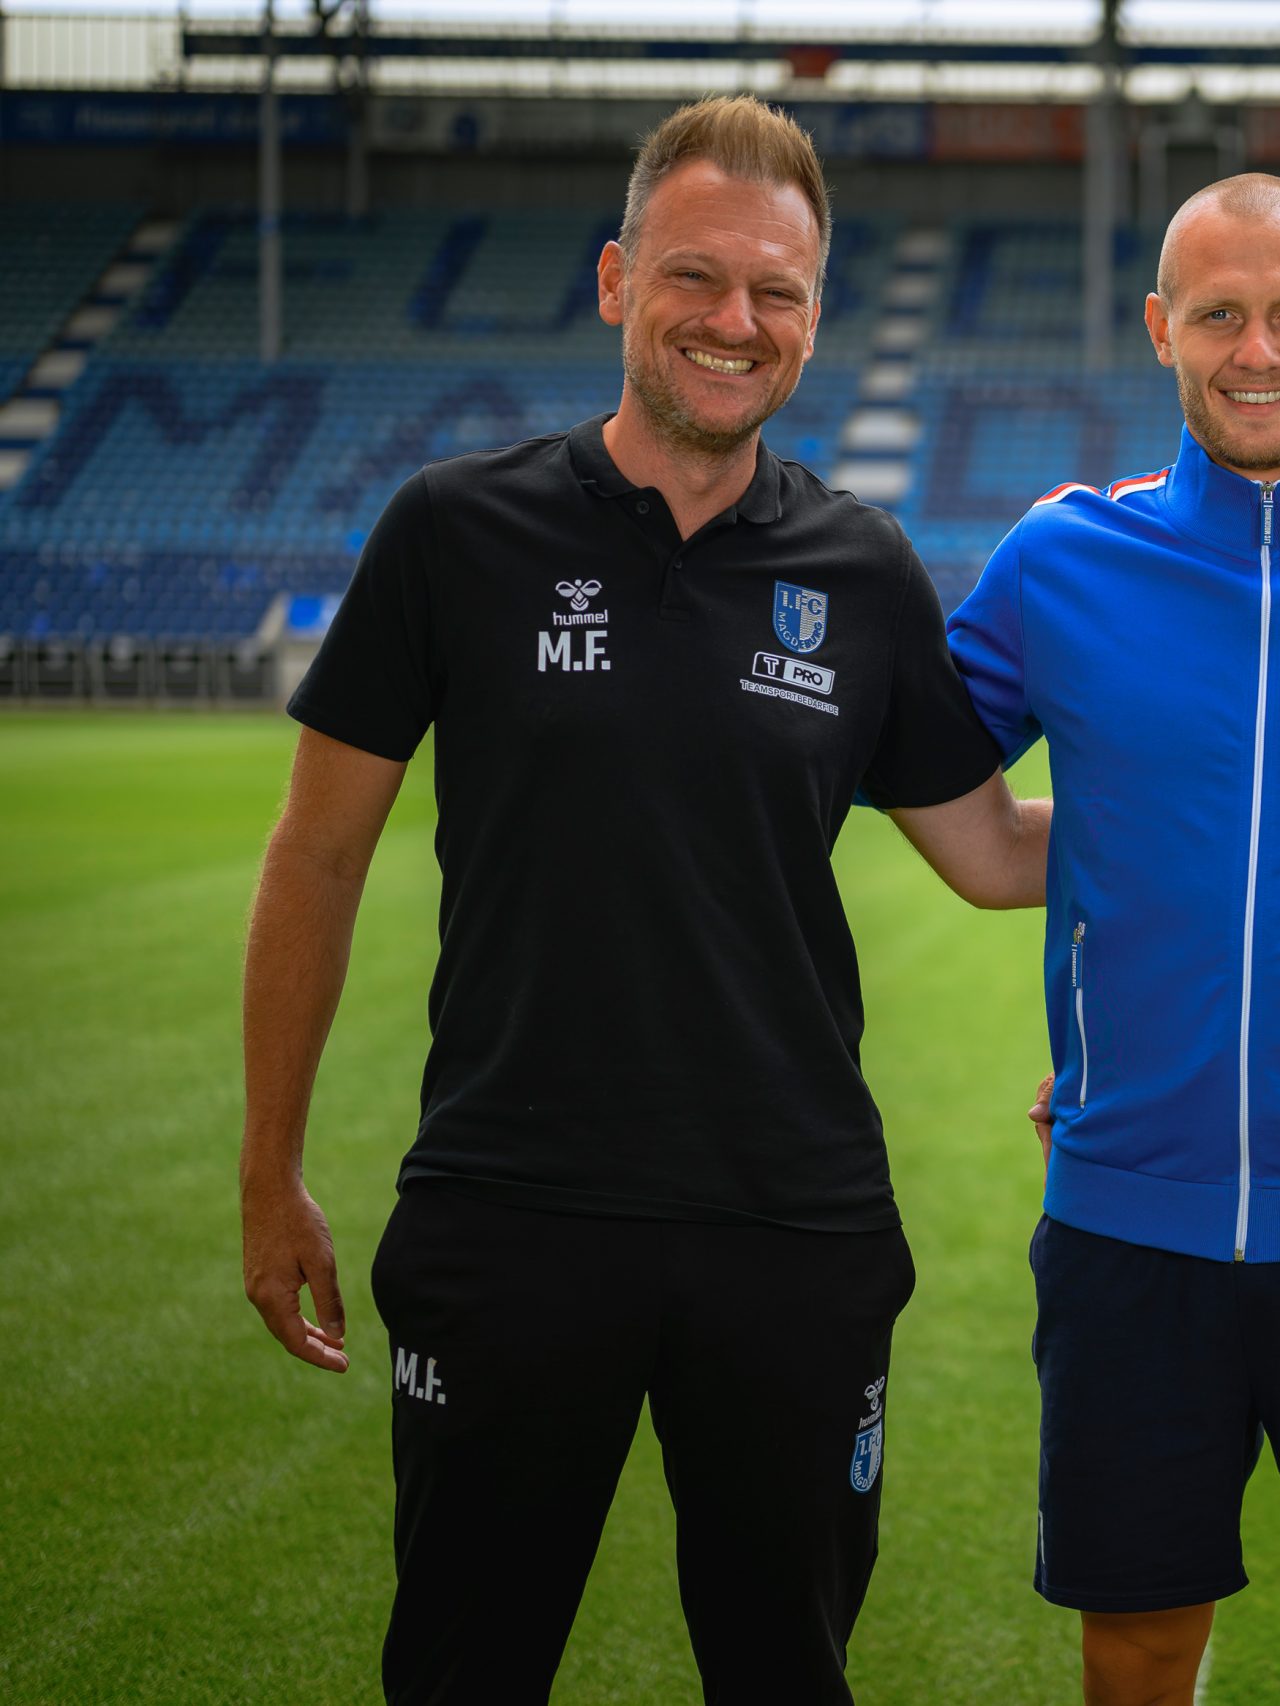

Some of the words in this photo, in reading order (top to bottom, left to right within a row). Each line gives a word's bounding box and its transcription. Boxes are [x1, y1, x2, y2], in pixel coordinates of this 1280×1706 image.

[552, 609, 608, 626] hummel
[537, 630, 611, 672] M.F.
[792, 666, 823, 686] PRO
